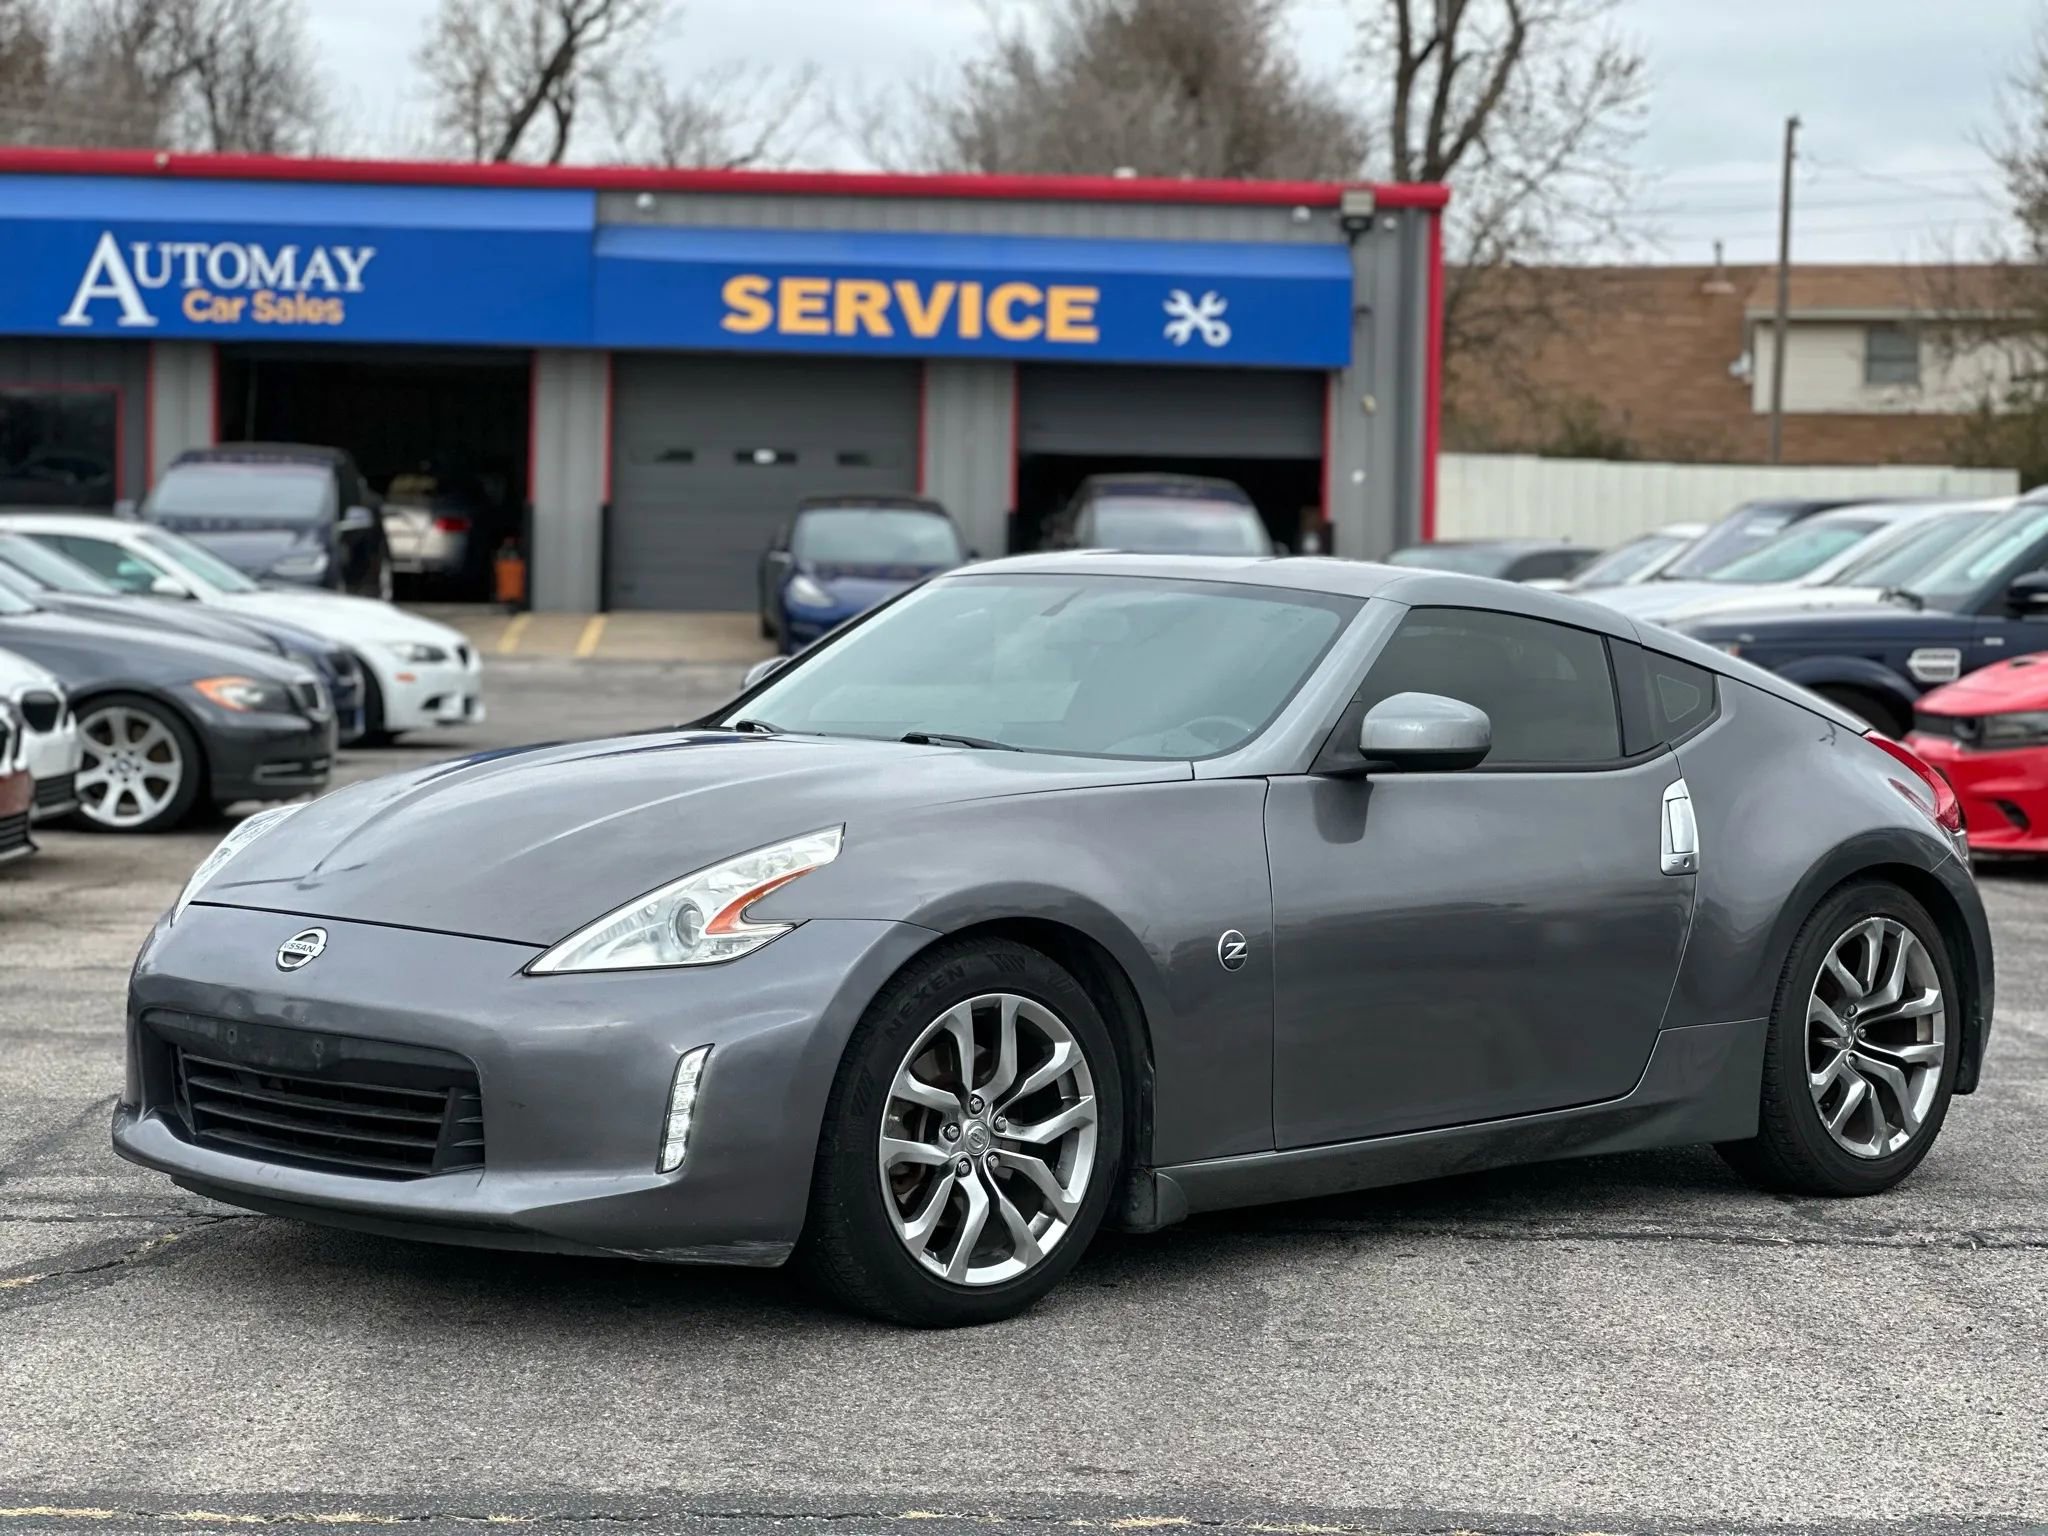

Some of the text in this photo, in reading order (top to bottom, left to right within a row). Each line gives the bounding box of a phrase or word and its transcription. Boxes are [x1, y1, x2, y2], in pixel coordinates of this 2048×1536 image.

[58, 230, 376, 326] AUTOMAY
[182, 288, 345, 325] Car Sales
[720, 274, 1099, 343] SERVICE
[1224, 942, 1248, 960] Z
[884, 963, 966, 1036] NEXEN
